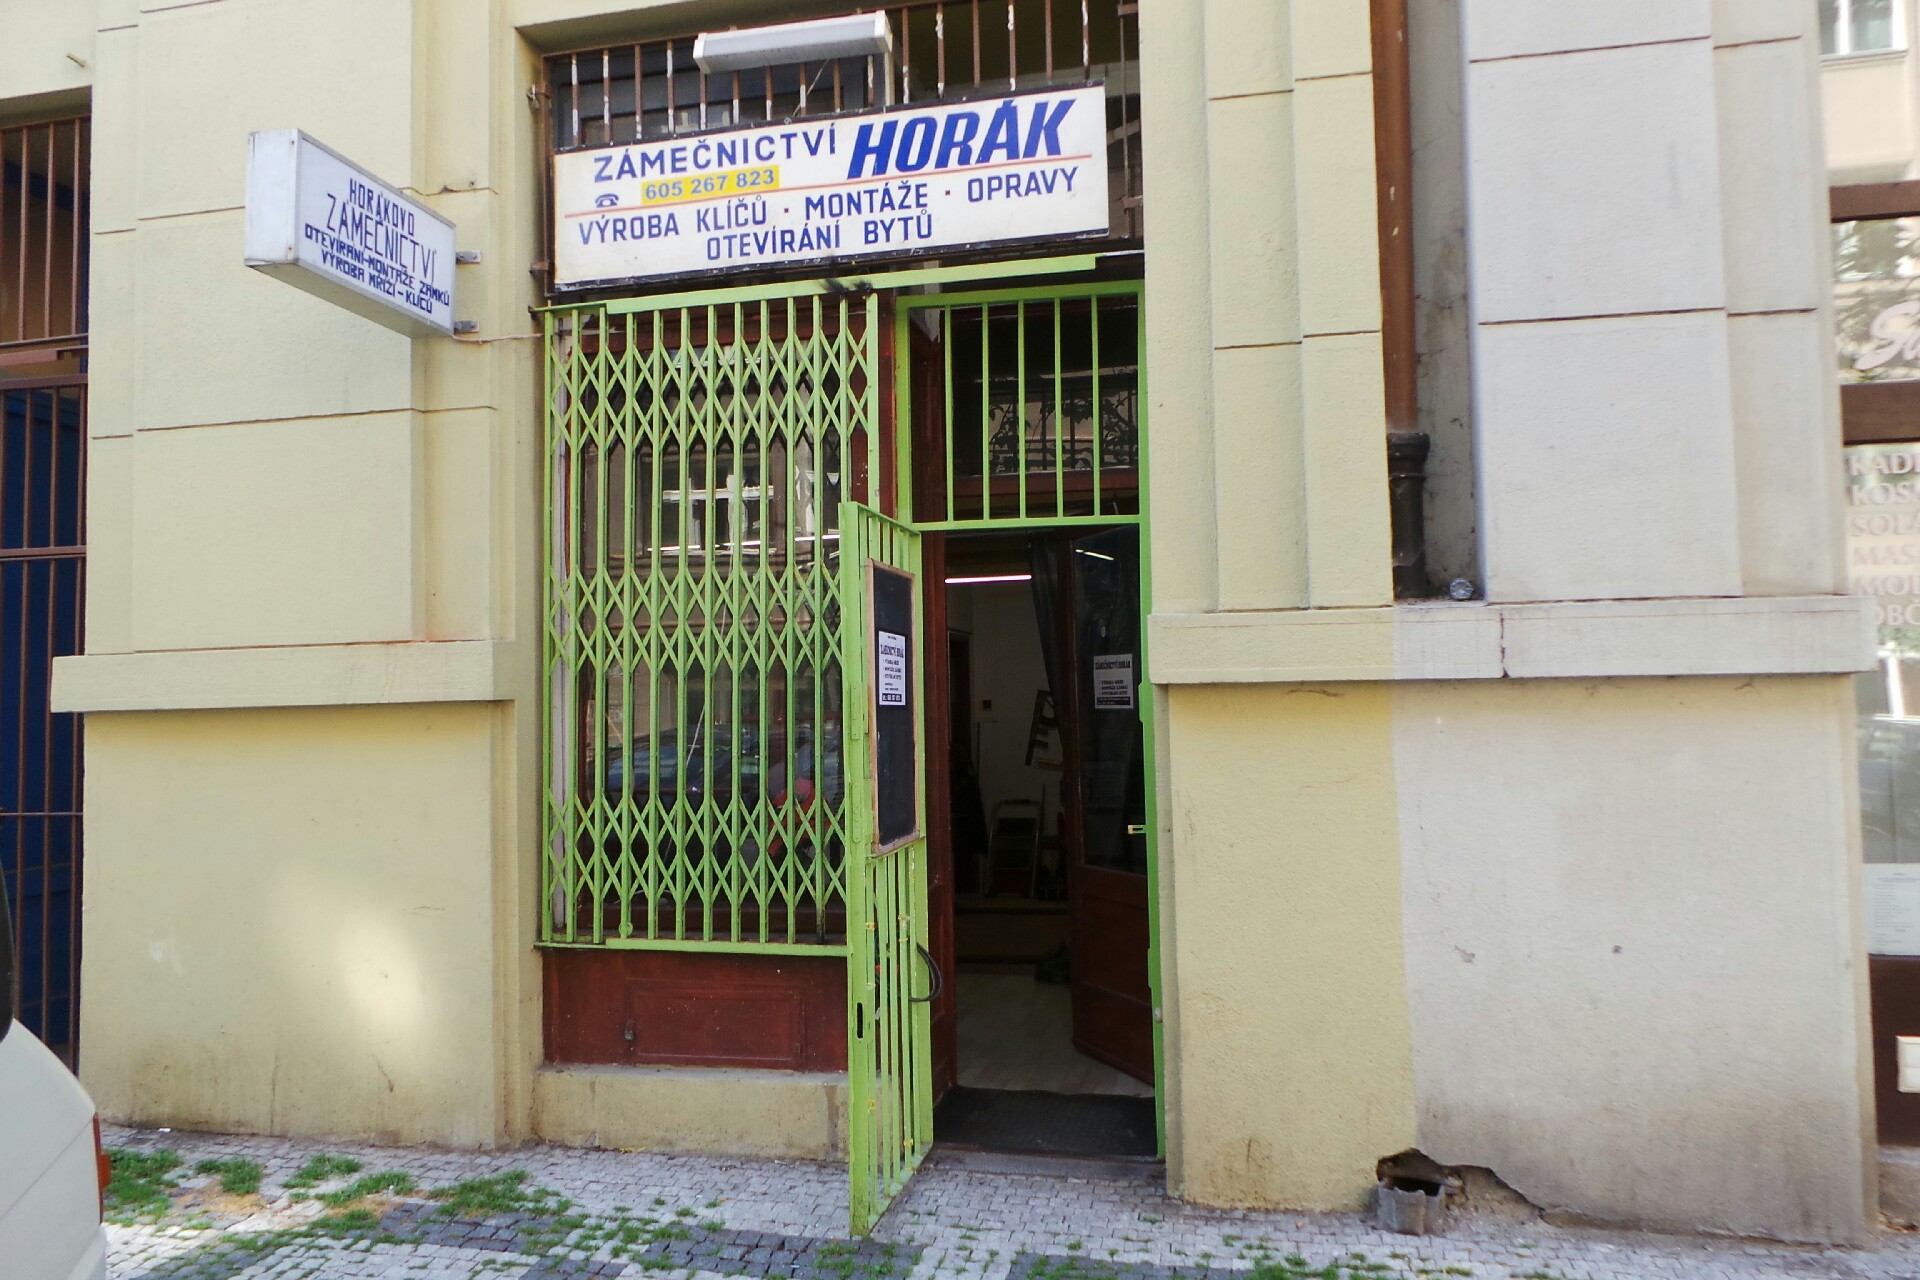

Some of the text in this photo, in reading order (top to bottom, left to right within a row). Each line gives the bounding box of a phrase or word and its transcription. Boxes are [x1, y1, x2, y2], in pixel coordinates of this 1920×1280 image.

[594, 98, 1077, 183] ZÁMEČNICTVÍ HORÁK
[349, 178, 415, 237] HORÁKOVO
[579, 166, 1079, 246] VÝROBA KLÍČŮ MONTÁŽE OPRAVY
[645, 168, 775, 200] 605 267 823
[327, 192, 437, 285] ZÁMEČNICTVÍ
[707, 208, 933, 261] OTEVÍRÁNÍ BYTŮ
[322, 248, 365, 283] VÝROBA
